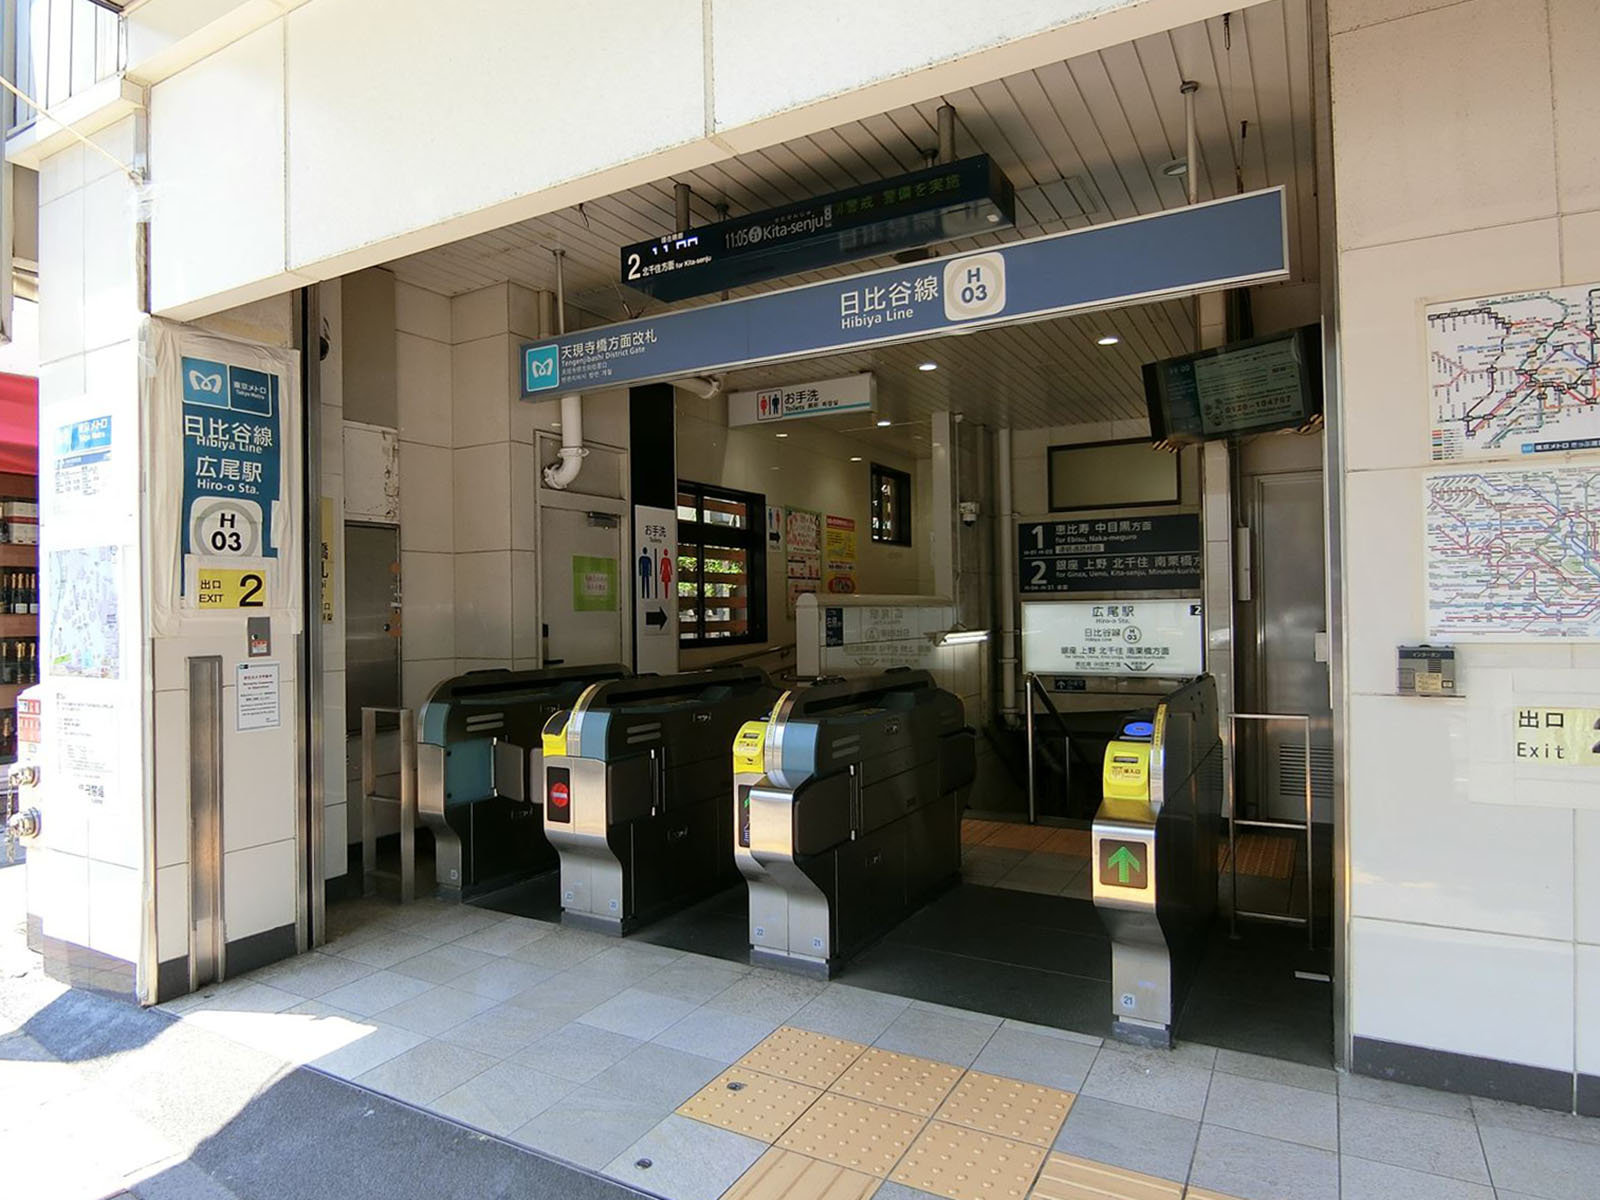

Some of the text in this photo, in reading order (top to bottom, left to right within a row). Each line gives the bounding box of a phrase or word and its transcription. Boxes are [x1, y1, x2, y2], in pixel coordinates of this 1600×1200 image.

[763, 214, 824, 241] Kita-senju
[627, 253, 641, 280] 2
[642, 260, 675, 277] 北千住方面
[967, 267, 981, 284] H
[840, 275, 939, 317] 日比谷線
[961, 284, 988, 304] 03
[841, 308, 914, 330] Hibiya Line
[561, 329, 657, 360] 天現寺橋方面改札
[605, 349, 629, 360] District
[629, 346, 646, 355] Gate
[234, 381, 267, 395] 東京メトロ
[784, 389, 819, 405] お手洗
[184, 415, 273, 448] 日比谷線
[196, 435, 263, 455] Hibiya Line
[195, 456, 262, 483] 広尾駅
[197, 479, 260, 495] Hiro-o Sta.
[219, 513, 236, 529] H
[1055, 521, 1152, 536] 恵比寿 中目黒方面
[645, 525, 667, 538] お手洗
[1031, 525, 1044, 549] 1
[211, 531, 243, 552] 03
[1056, 559, 1078, 571] 銀座
[1084, 558, 1107, 570] 上野
[1112, 556, 1149, 569] 北千住
[1030, 560, 1047, 585] 2
[200, 579, 221, 590] 出口
[239, 574, 264, 608] 2
[199, 594, 224, 604] EXIT
[1092, 605, 1135, 618] 広尾駅
[1084, 627, 1121, 638] 日比谷線
[1081, 646, 1096, 655] 上野
[1099, 647, 1123, 656] 北千住
[1519, 710, 1564, 729] 出口
[1517, 742, 1565, 760] Exit
[1123, 995, 1133, 1006] 21
